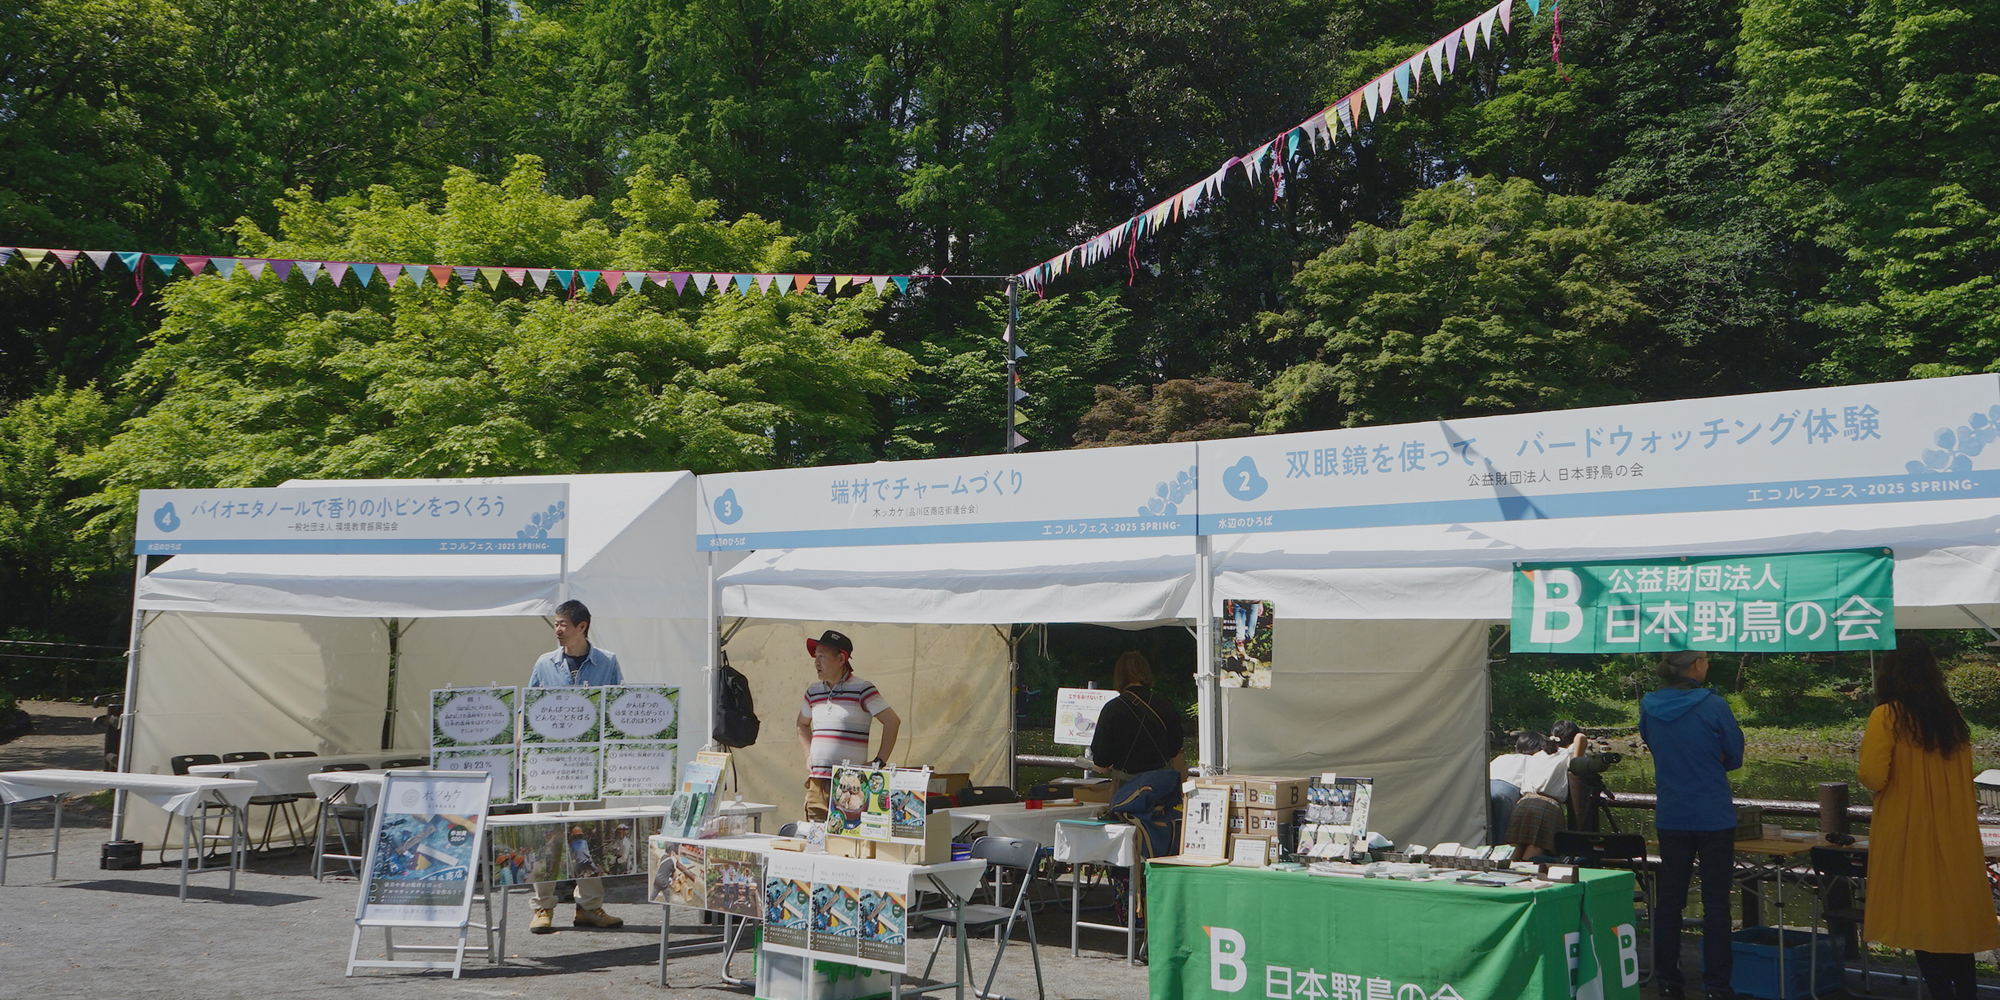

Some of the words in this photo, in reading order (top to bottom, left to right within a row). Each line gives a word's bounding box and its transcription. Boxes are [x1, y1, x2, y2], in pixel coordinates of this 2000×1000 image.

[1238, 470, 1250, 492] 2
[1467, 468, 1551, 486] 公益財団法人
[1558, 462, 1644, 481] 日本野鳥の会
[831, 469, 1024, 506] 端材でチャームづくり
[191, 496, 505, 519] バイオエタノールで香りの小ビンをつくろう
[723, 499, 732, 515] 3
[162, 512, 171, 526] 4
[287, 522, 334, 532] 一般社団法人
[335, 521, 399, 532] 環境教育振興協会
[1218, 515, 1273, 529] 水辺のひろば
[147, 543, 182, 551] 水辺のひろば
[710, 536, 746, 547] 水辺のひろば
[1607, 562, 1782, 595] 公益財団法人
[1529, 569, 1584, 643] B
[1605, 594, 1884, 643] 日本野鳥の会
[1209, 926, 1248, 993] B
[1616, 923, 1639, 989] B
